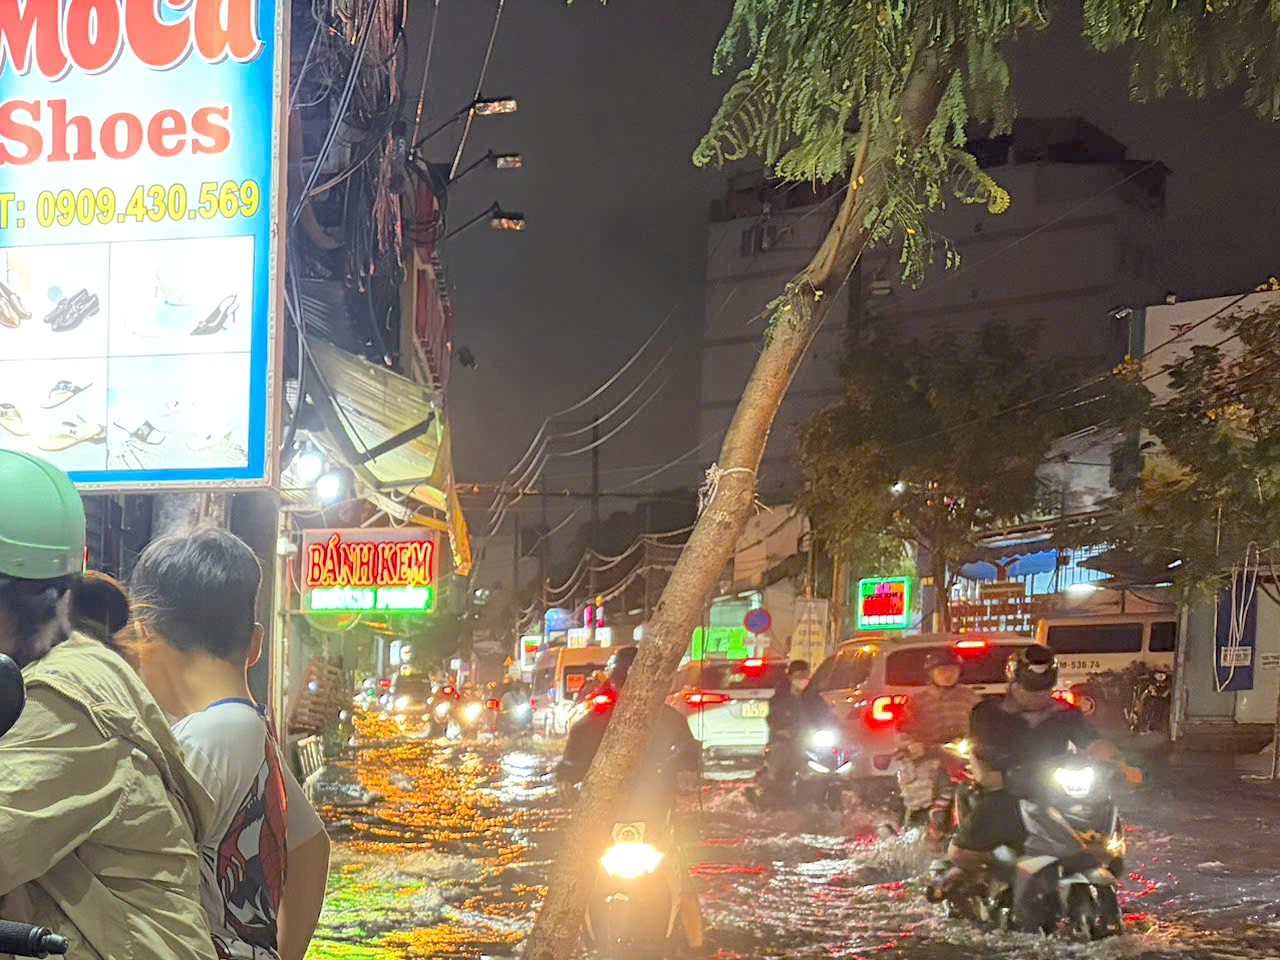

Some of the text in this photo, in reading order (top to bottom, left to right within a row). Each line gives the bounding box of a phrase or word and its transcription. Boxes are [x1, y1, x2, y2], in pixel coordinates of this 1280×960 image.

[37, 180, 260, 227] 0909.430.569
[307, 533, 433, 586] BÁNH KEM
